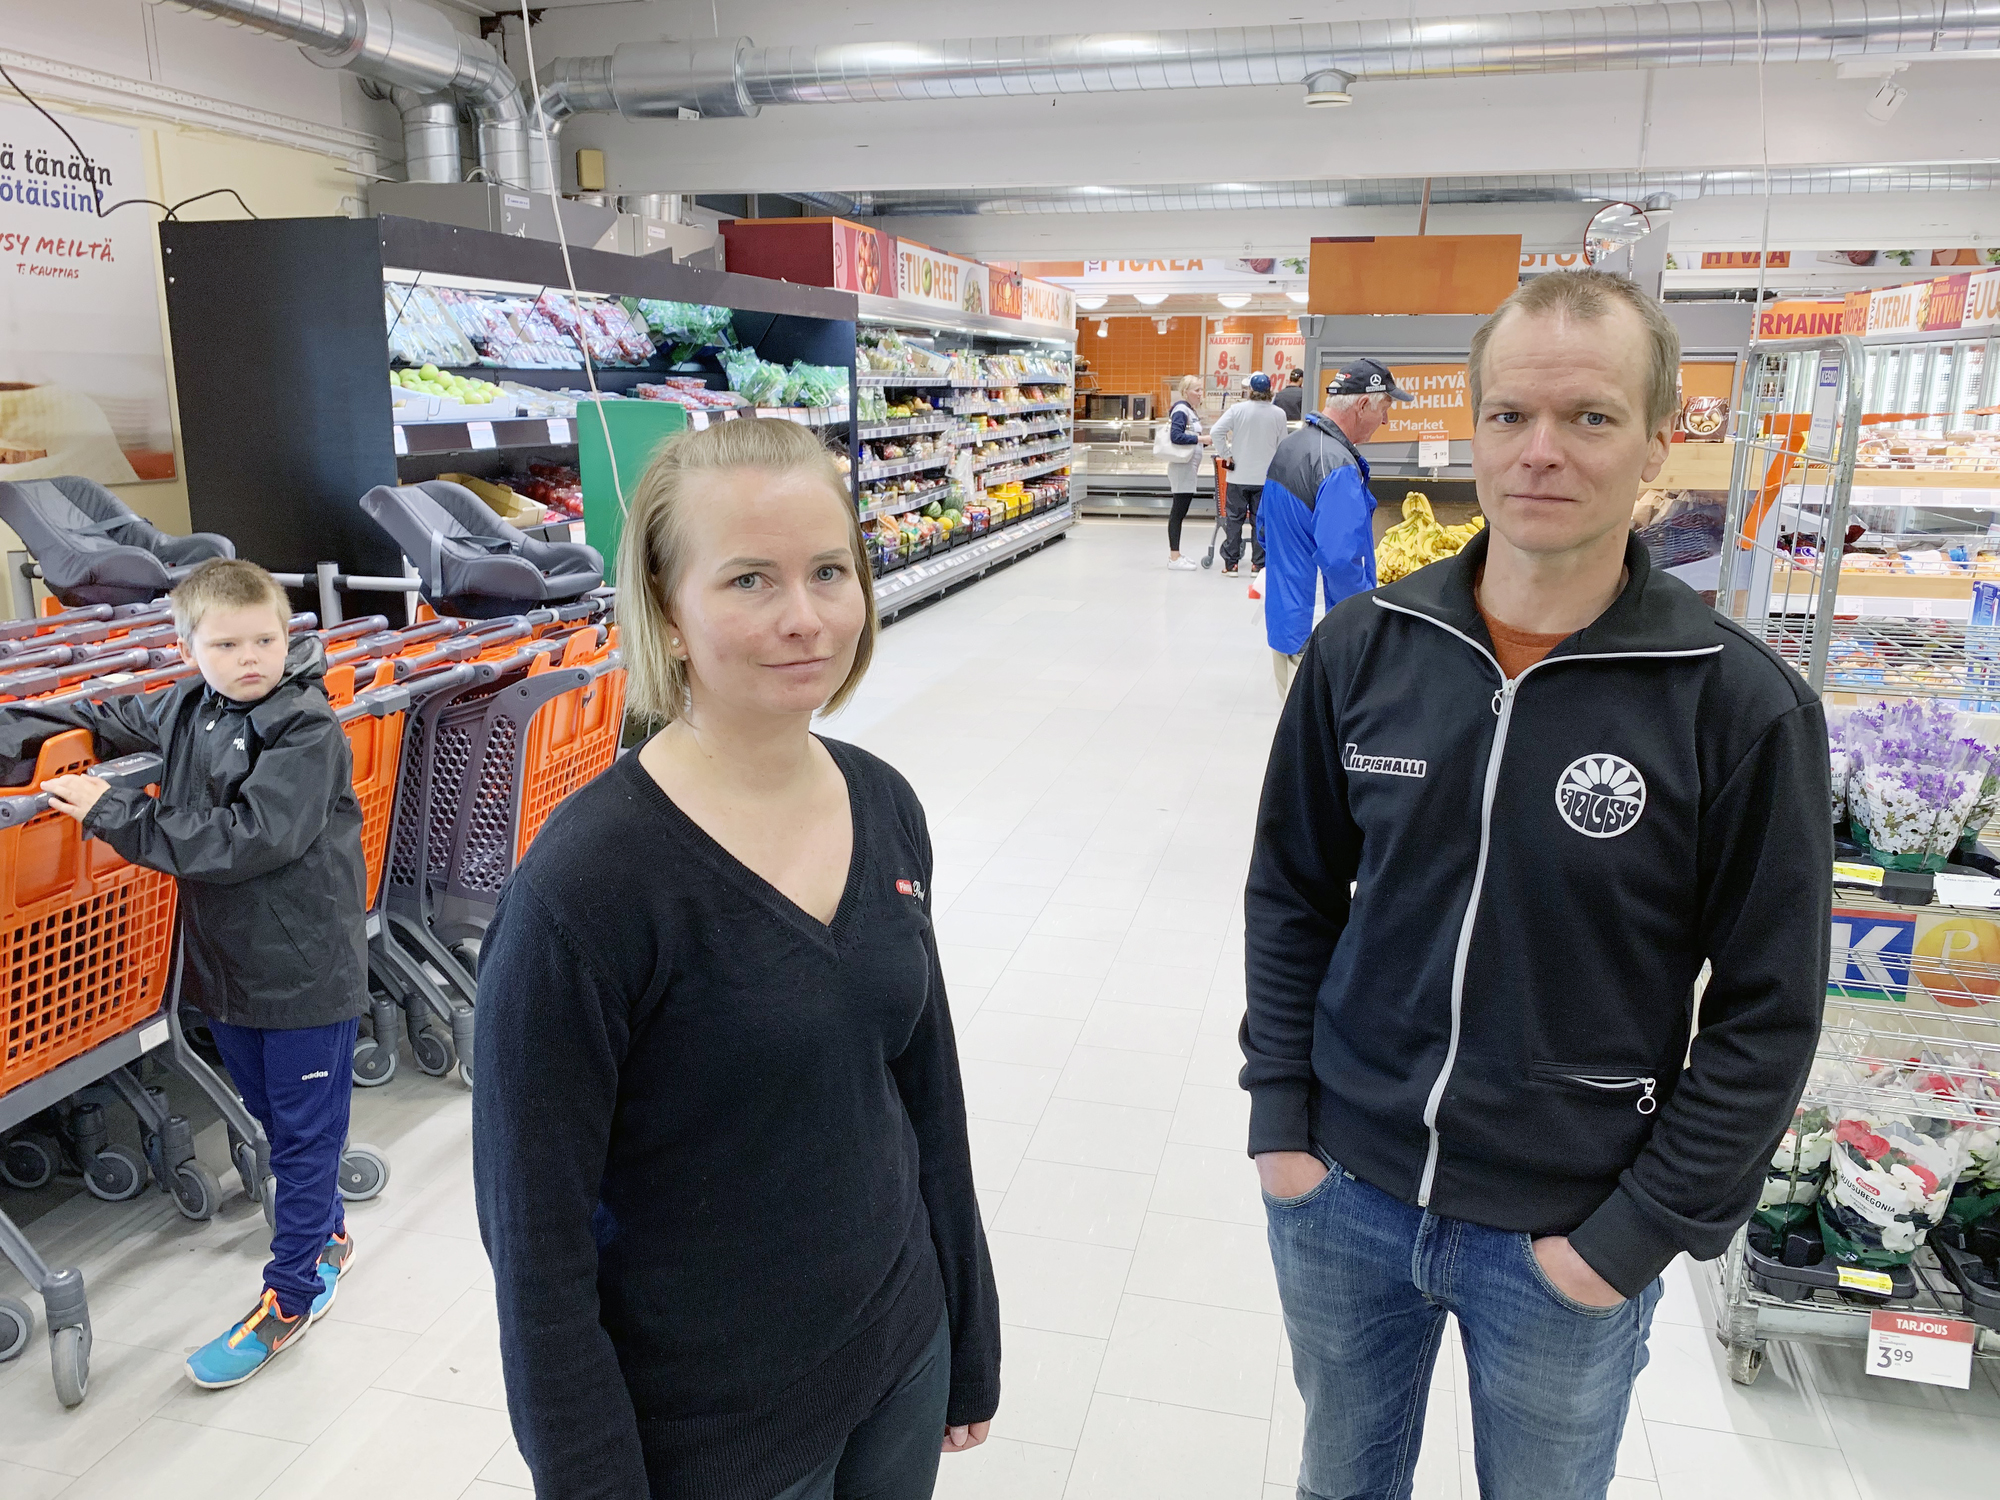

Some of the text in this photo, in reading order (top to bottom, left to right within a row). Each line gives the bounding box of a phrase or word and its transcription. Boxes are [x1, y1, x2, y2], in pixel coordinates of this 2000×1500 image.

[25, 149, 112, 186] tänään
[36, 237, 114, 262] MEILTÄ.
[30, 264, 79, 279] KAUPPIAS
[905, 252, 958, 302] TUOREET
[1873, 293, 1912, 330] ATERIA
[1965, 284, 1977, 319] HETI
[1218, 351, 1228, 370] 8
[1274, 350, 1284, 370] 9
[1424, 371, 1466, 390] HYVÄ
[1820, 370, 1838, 383] KESKO
[1402, 390, 1464, 410] LÄHELLÄ
[302, 1070, 329, 1081] adidas
[1896, 1318, 1949, 1336] TARJOUS
